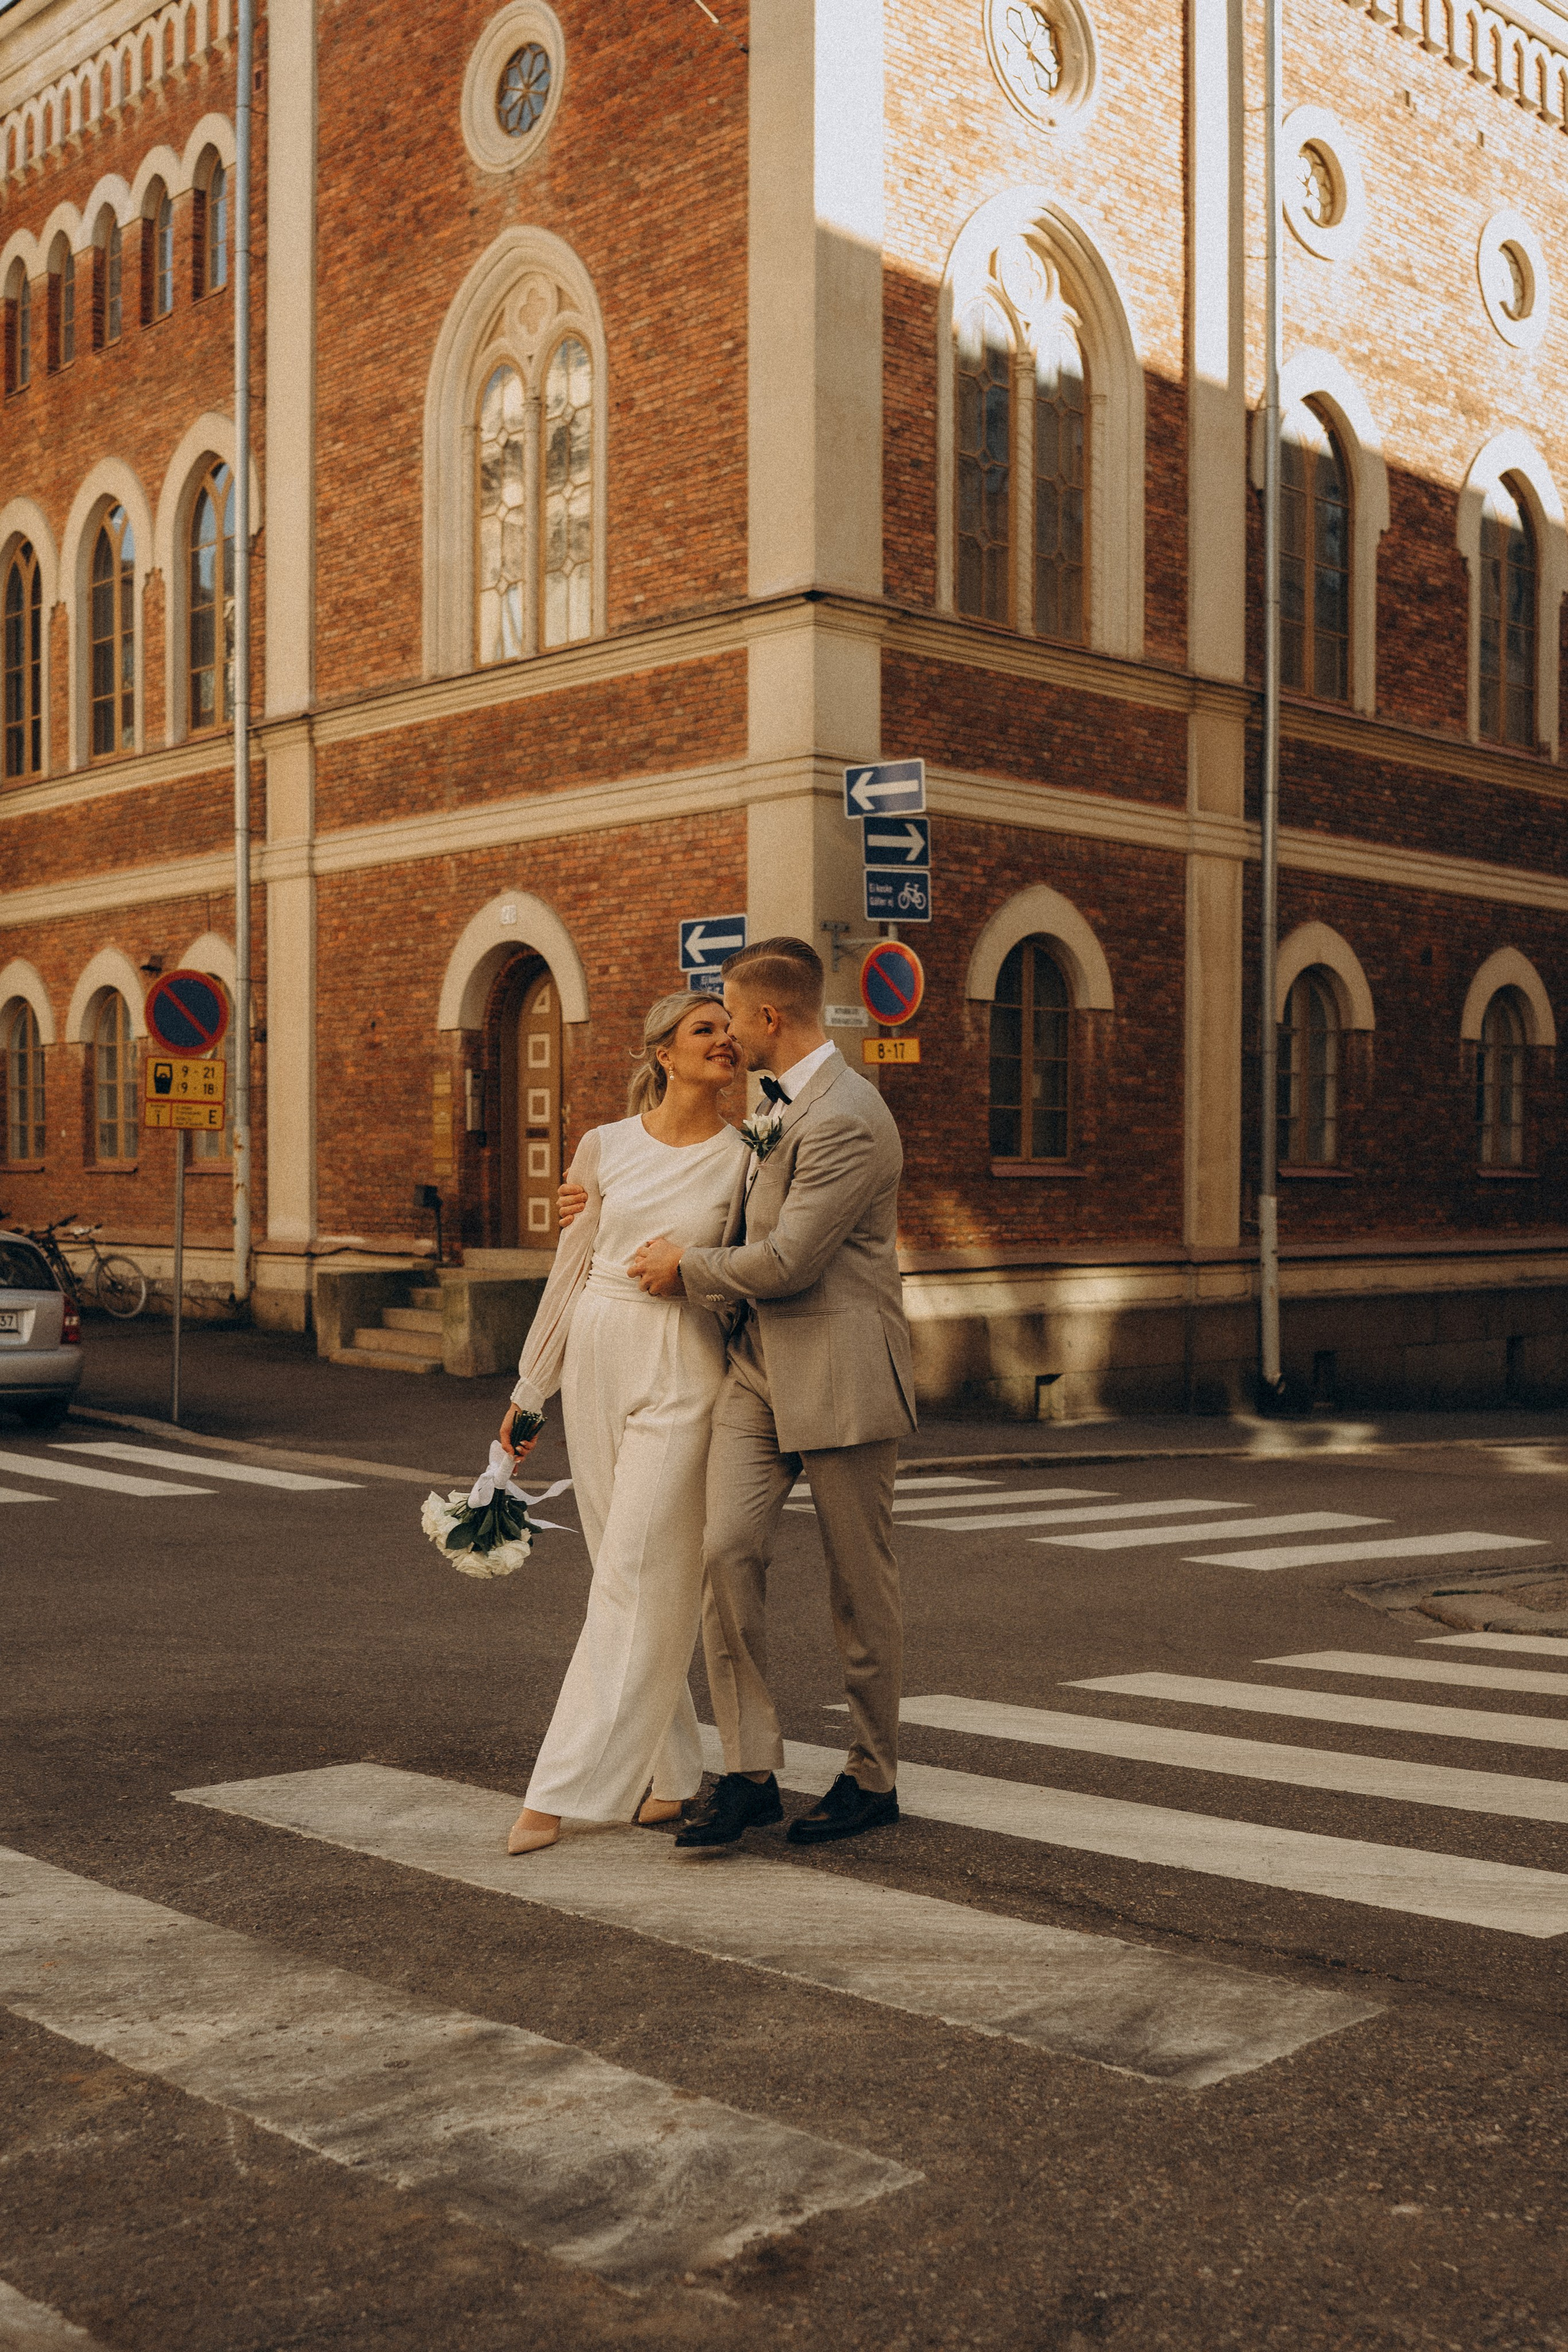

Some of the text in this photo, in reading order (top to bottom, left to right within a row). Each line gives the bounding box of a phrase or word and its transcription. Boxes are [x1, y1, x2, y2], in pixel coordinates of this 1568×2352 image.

[181, 1066, 189, 1077] 9
[203, 1067, 215, 1079] 21
[209, 1109, 217, 1125] E
